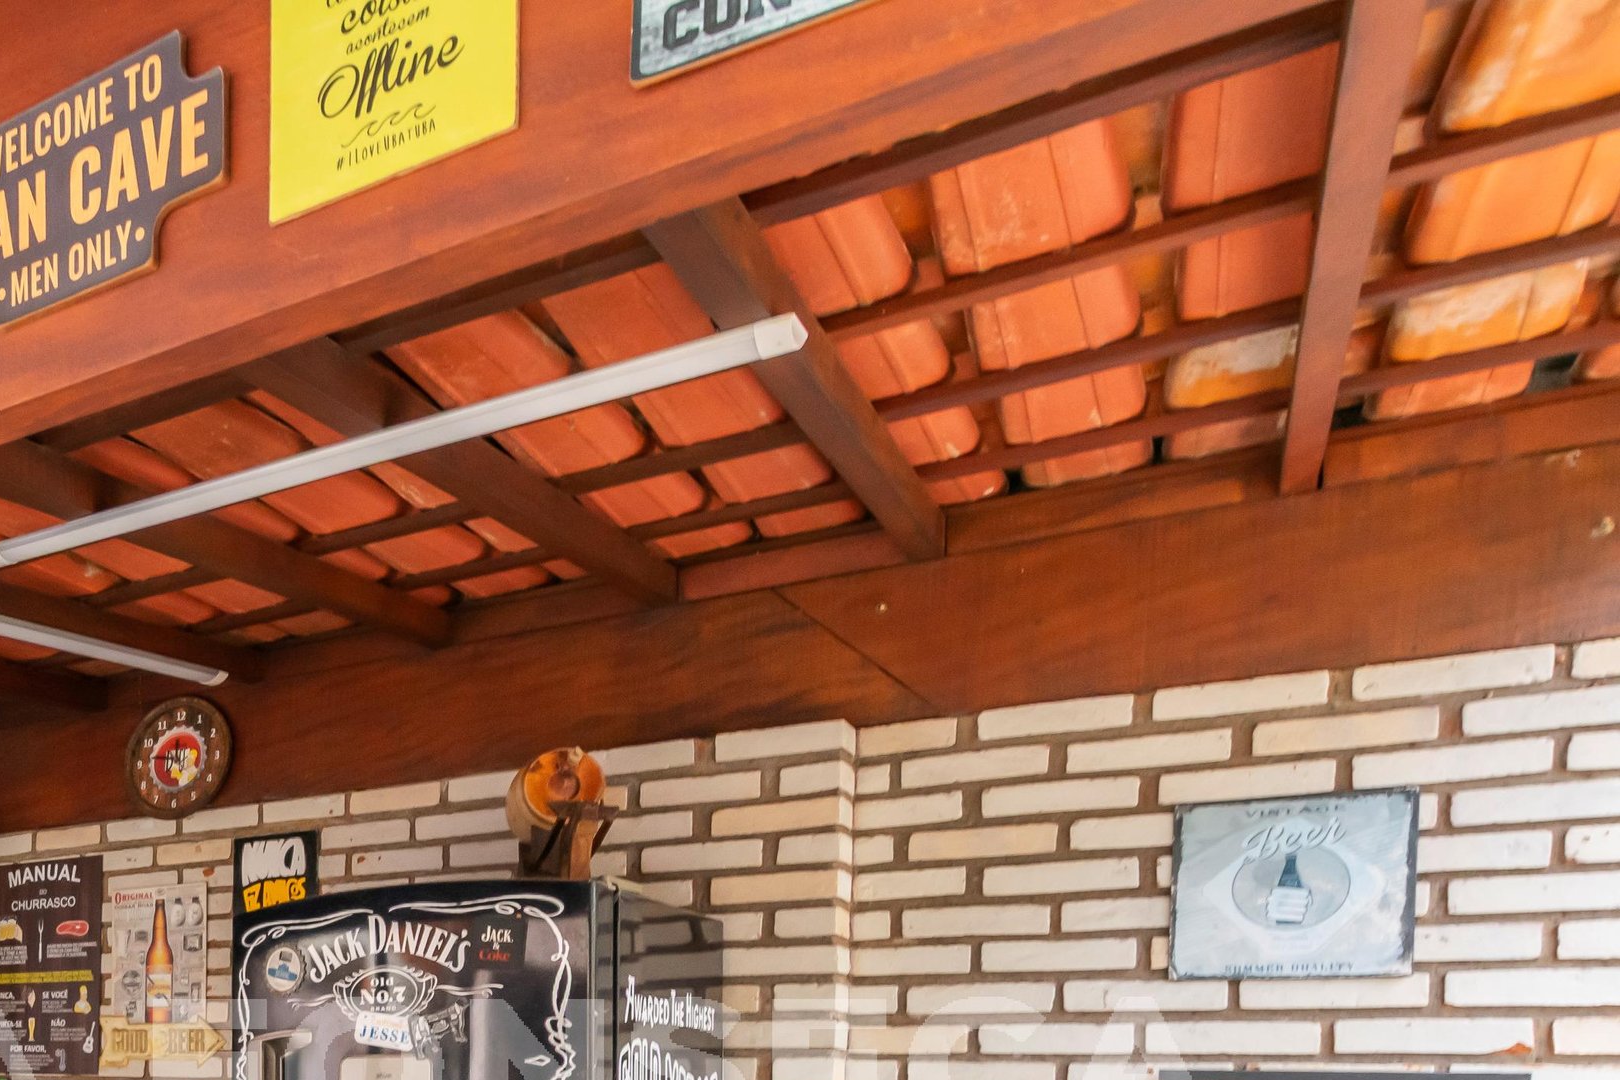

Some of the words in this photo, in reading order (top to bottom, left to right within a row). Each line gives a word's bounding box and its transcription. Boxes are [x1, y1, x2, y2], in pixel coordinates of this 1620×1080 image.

[346, 6, 430, 55] acontecem
[124, 54, 162, 111] TO
[317, 35, 465, 118] Offline
[70, 89, 209, 225] CAVE
[11, 254, 59, 307] MEN
[68, 220, 132, 281] ONLY
[176, 711, 187, 721] 12
[197, 715, 202, 724] 1
[157, 721, 168, 730] 11
[210, 728, 216, 738] 2
[143, 738, 154, 748] 10
[214, 750, 220, 760] 3
[137, 760, 143, 769] 9
[206, 773, 212, 783] 4
[140, 781, 147, 790] 8
[153, 795, 159, 804] 7
[190, 791, 196, 801] 5
[171, 799, 177, 808] 6
[1245, 803, 1346, 818] VINTAGE
[1242, 816, 1347, 863] Beer
[8, 863, 81, 888] MANUAL
[11, 896, 76, 912] CHURRASCO
[115, 892, 152, 905] ORIGINAL
[481, 925, 512, 943] JACK
[306, 928, 364, 983] JACK
[367, 914, 472, 974] DANIEL'S
[370, 976, 394, 988] Old
[359, 1025, 410, 1044] JESSE
